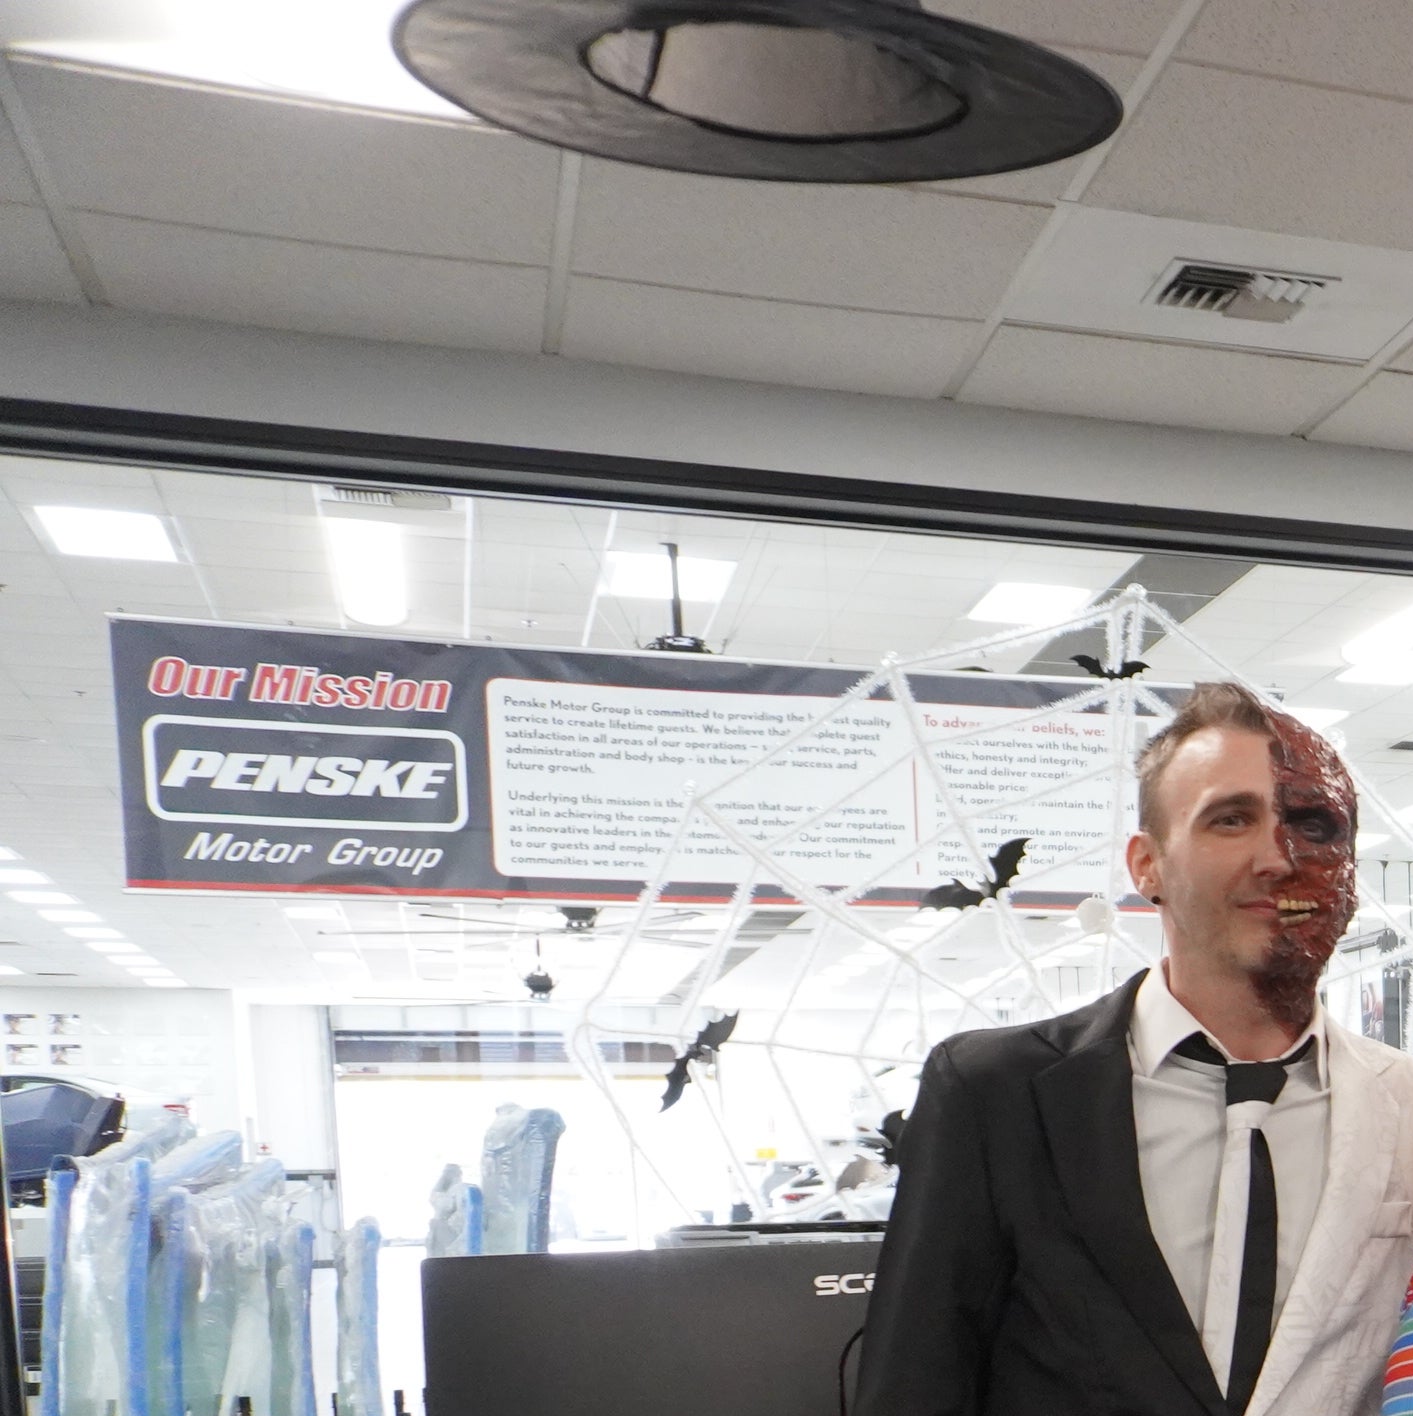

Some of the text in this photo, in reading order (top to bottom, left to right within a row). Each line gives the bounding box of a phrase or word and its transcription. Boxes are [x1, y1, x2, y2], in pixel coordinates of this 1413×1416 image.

[148, 656, 452, 713] Our Mission
[504, 696, 547, 708] Penske
[550, 700, 587, 712] Motor
[592, 702, 631, 715] Group
[634, 707, 643, 715] is
[647, 708, 709, 719] committed
[713, 710, 724, 720] to
[728, 711, 783, 723] providing
[787, 712, 804, 721] the
[852, 717, 890, 728] quality
[505, 714, 548, 725] service
[552, 716, 563, 725] to
[567, 718, 605, 728] create
[609, 719, 653, 731] lifetime
[657, 724, 697, 734] guests.
[703, 725, 720, 734] We
[724, 725, 764, 736] believe
[850, 732, 880, 742] guest
[924, 714, 938, 728] To
[1083, 727, 1105, 737] we:
[505, 729, 575, 742] satisfaction
[578, 732, 589, 743] in
[593, 733, 607, 743] all
[611, 737, 643, 746] areas
[647, 737, 657, 746] of
[662, 738, 680, 748] our
[685, 740, 747, 751] operations
[798, 745, 840, 755] service,
[844, 747, 876, 756] parts,
[983, 740, 1032, 748] ourselves
[1036, 741, 1059, 751] with
[1062, 743, 1078, 752] the
[506, 745, 595, 758] administration
[599, 750, 621, 760] and
[625, 752, 653, 763] body
[658, 754, 684, 764] shop
[697, 755, 706, 764] is
[709, 754, 728, 764] the
[792, 760, 832, 769] success
[836, 761, 858, 769] and
[507, 759, 594, 774] future growth.
[972, 752, 1013, 764] honesty
[1017, 754, 1037, 764] and
[161, 749, 453, 799] PENSKE
[968, 766, 987, 776] and
[991, 767, 1026, 777] deliver
[508, 790, 578, 805] Underlying
[582, 794, 602, 804] this
[607, 797, 650, 807] mission
[654, 798, 662, 808] is
[666, 798, 684, 808] the
[758, 802, 782, 812] that
[784, 804, 803, 812] our
[1038, 801, 1084, 809] maintain
[1087, 802, 1104, 810] the
[510, 808, 536, 817] vital
[540, 810, 549, 818] in
[554, 810, 612, 822] achieving
[616, 812, 634, 822] the
[737, 817, 758, 826] and
[846, 822, 905, 831] reputation
[937, 810, 946, 818] in
[510, 824, 895, 845] as innovative leaders in the Our commitment
[978, 827, 997, 835] and
[1001, 829, 1045, 838] promote
[184, 832, 443, 875] Motor Group
[510, 839, 522, 848] to
[551, 842, 589, 852] guests
[593, 842, 615, 851] and
[790, 849, 831, 859] respect
[835, 849, 850, 859] for
[854, 850, 871, 860] the
[511, 856, 648, 868] communities we serve.
[939, 869, 977, 878] society.
